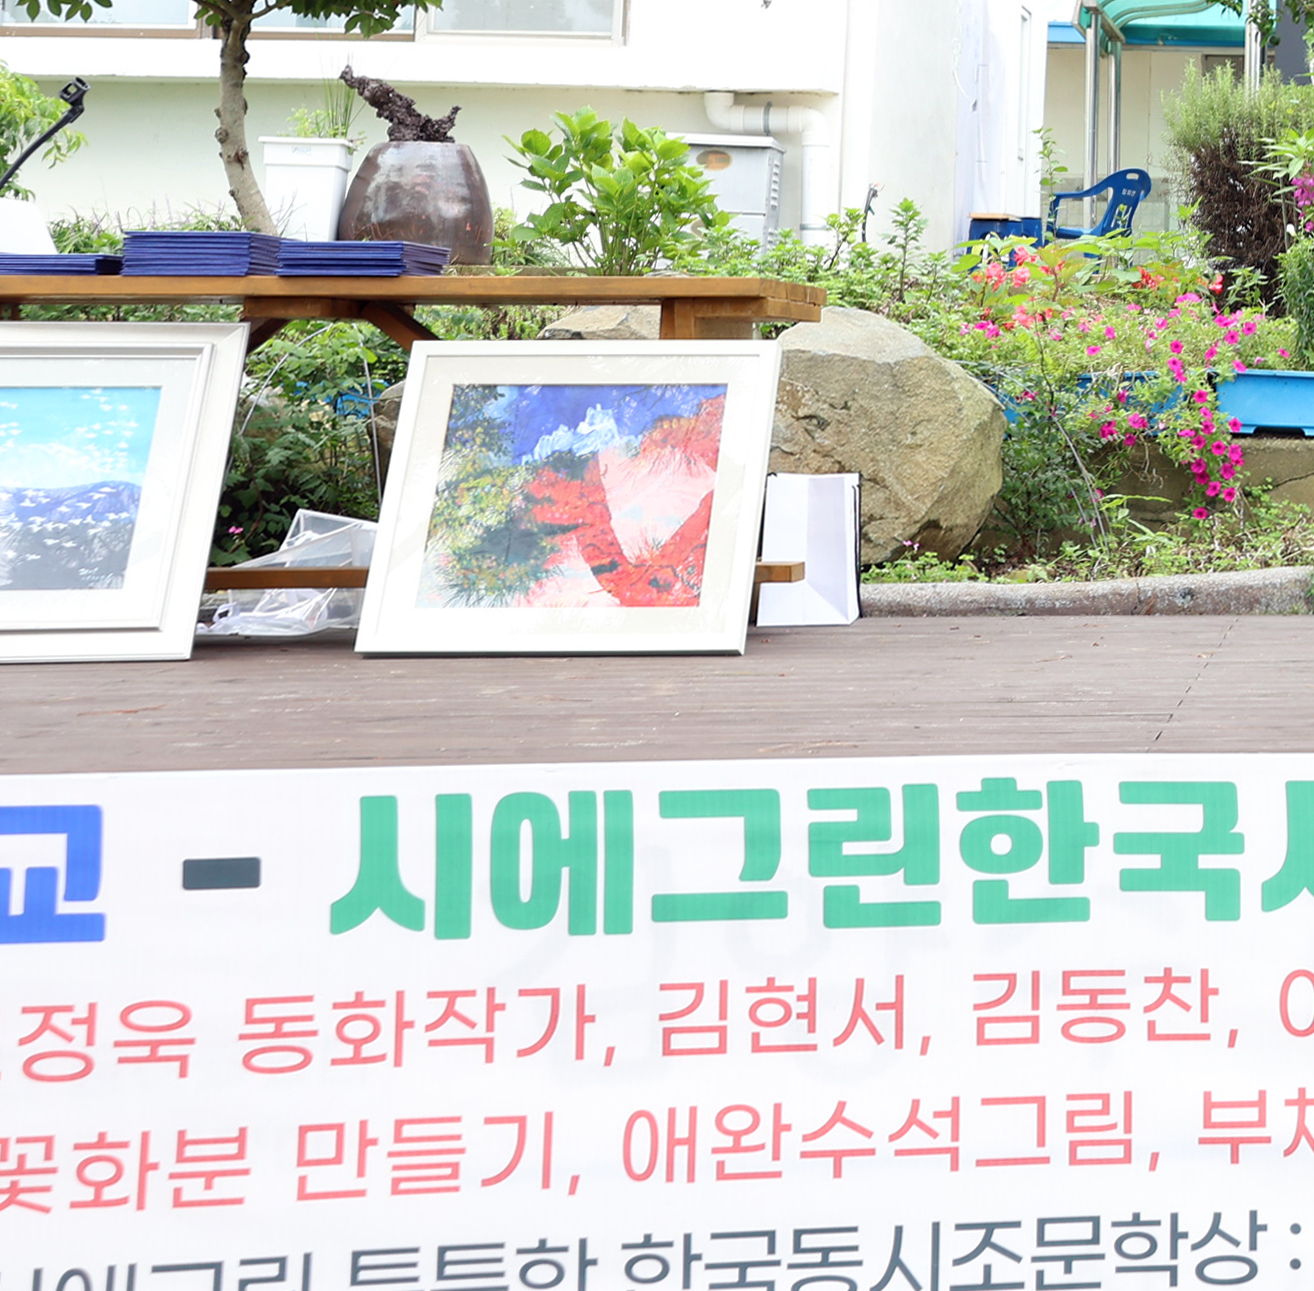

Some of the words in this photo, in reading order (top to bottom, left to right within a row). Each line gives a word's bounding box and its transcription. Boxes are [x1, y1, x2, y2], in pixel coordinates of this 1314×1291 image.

[0, 805, 105, 944] 교
[238, 984, 615, 1074] 동화작가,
[659, 975, 930, 1056] 김현서,
[973, 967, 1238, 1048] 김동찬,
[0, 1127, 251, 1214] 꽃화분
[297, 1112, 580, 1201] 만들기,
[623, 1091, 1159, 1183] 애완수석그림,
[622, 1210, 1267, 1291] 한국동시조문학상
